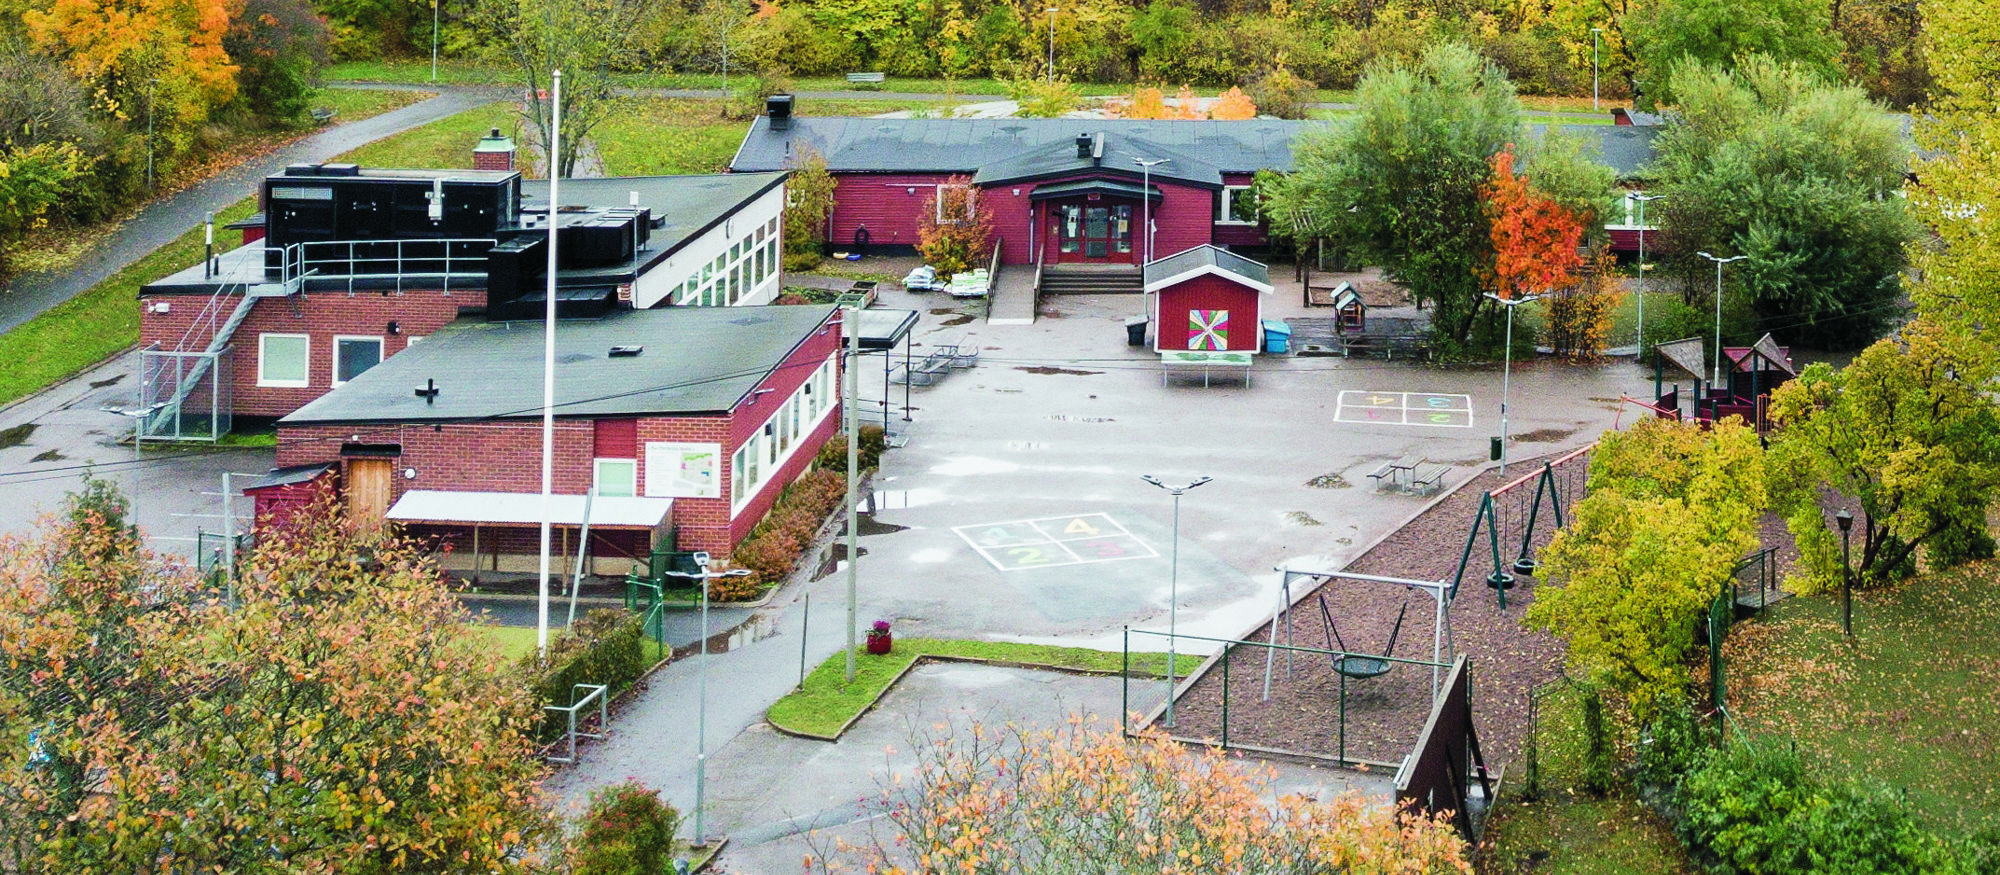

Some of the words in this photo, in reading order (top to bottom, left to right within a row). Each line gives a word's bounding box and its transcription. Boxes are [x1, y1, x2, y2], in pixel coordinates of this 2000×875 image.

[1063, 517, 1100, 536] 4
[1007, 547, 1049, 564] 2
[1086, 541, 1125, 557] 3
